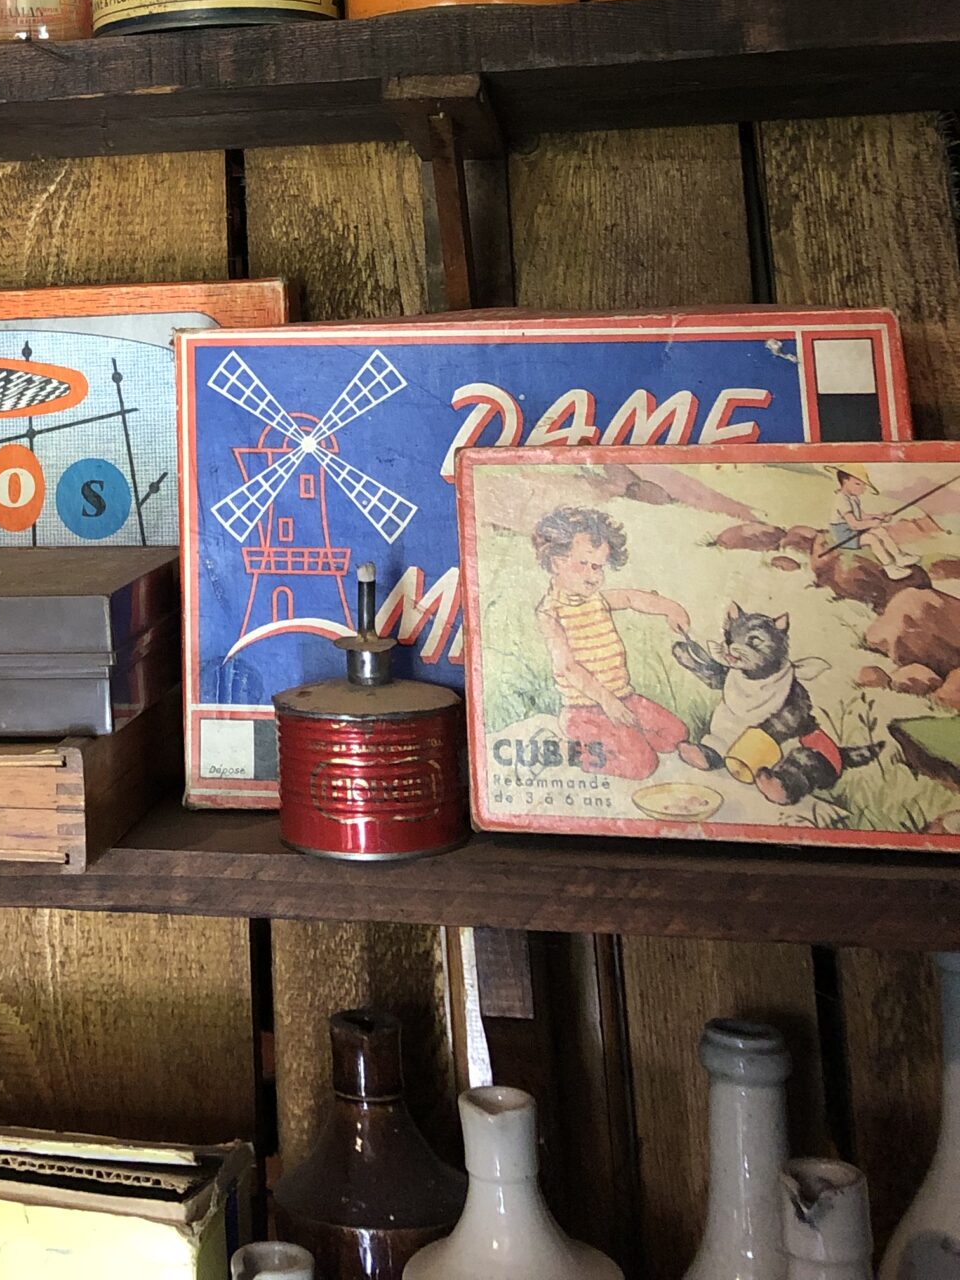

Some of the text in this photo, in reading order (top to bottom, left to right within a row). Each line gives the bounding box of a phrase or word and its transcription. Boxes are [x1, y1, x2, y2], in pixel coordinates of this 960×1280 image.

[492, 738, 608, 769] CUBES
[493, 774, 611, 790] Recommandé
[494, 791, 612, 808] de 3 à 6 ans
